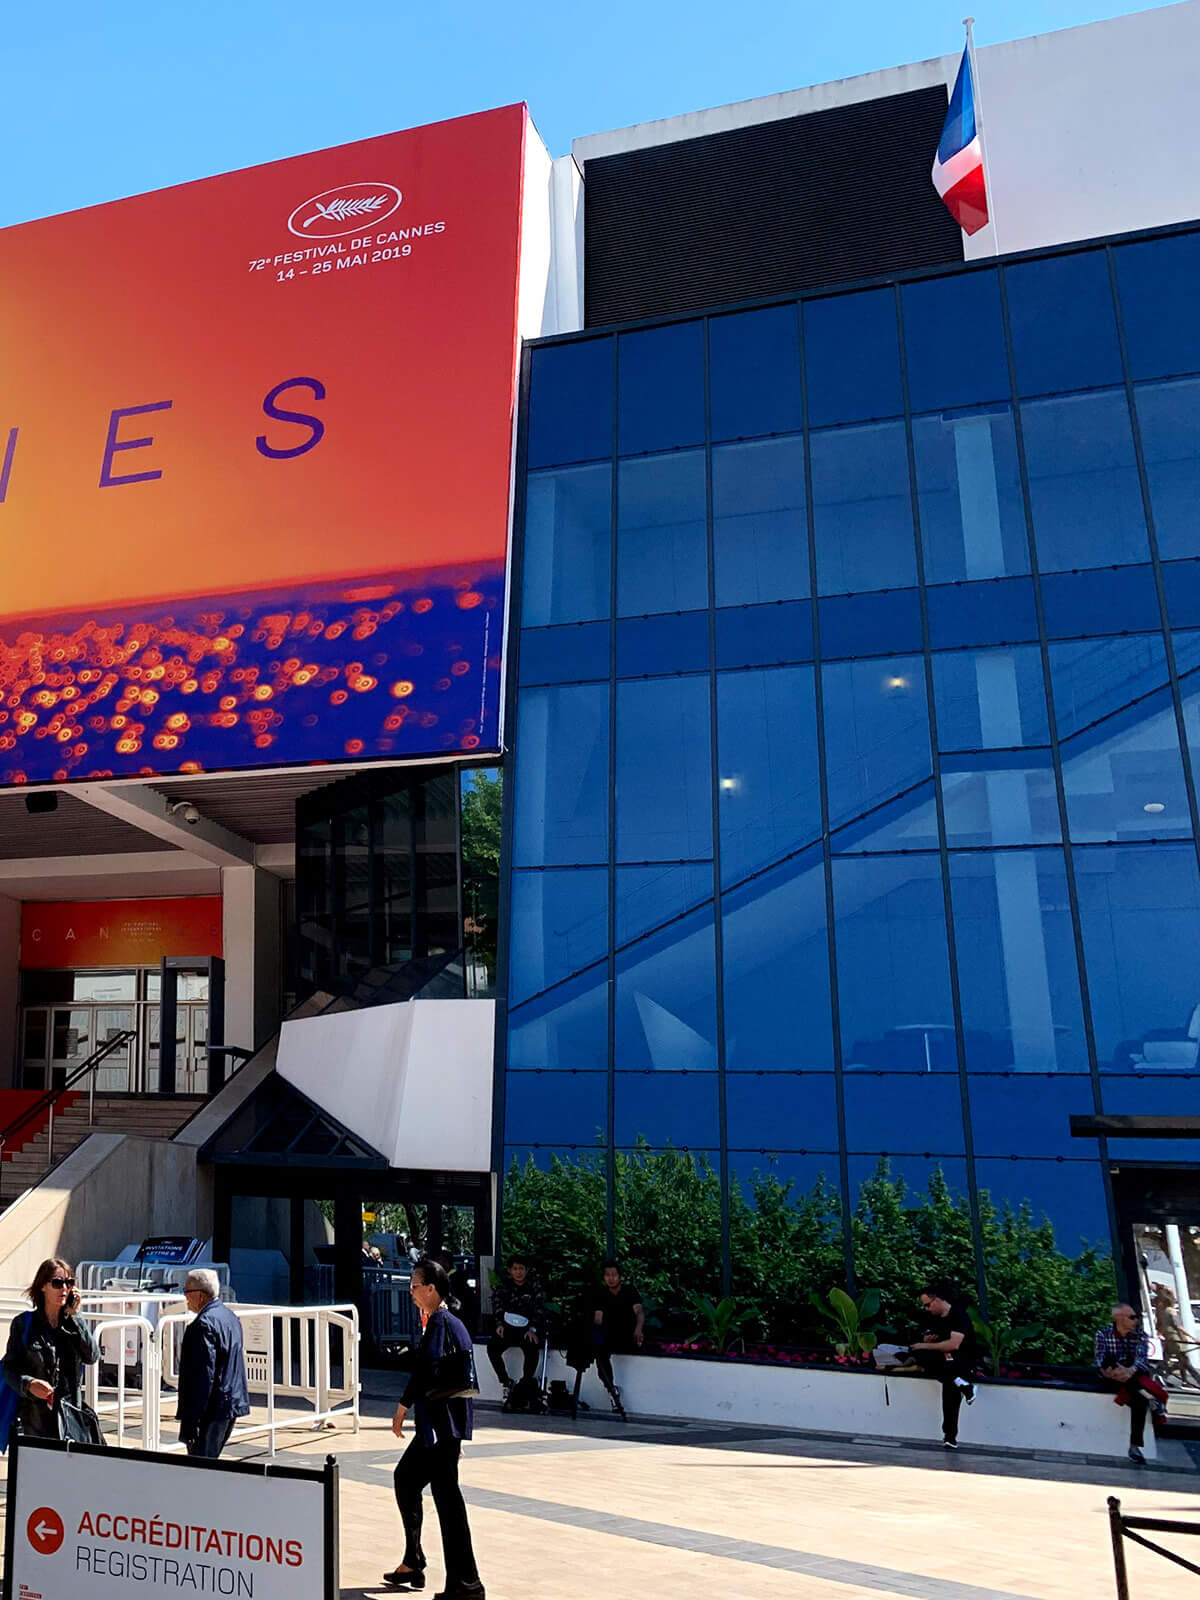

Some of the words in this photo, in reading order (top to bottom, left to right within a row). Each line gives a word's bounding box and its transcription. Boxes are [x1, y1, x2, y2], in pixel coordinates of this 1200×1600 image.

[273, 242, 347, 267] FESTIVAL
[350, 236, 373, 251] DE
[376, 221, 447, 245] CANNES
[276, 270, 295, 282] 14
[312, 260, 332, 275] 25
[336, 253, 368, 271] MAI
[371, 244, 412, 263] 2019
[77, 1511, 303, 1567] ACCRÉDITATIONS
[76, 1546, 255, 1598] REGISTRATION
